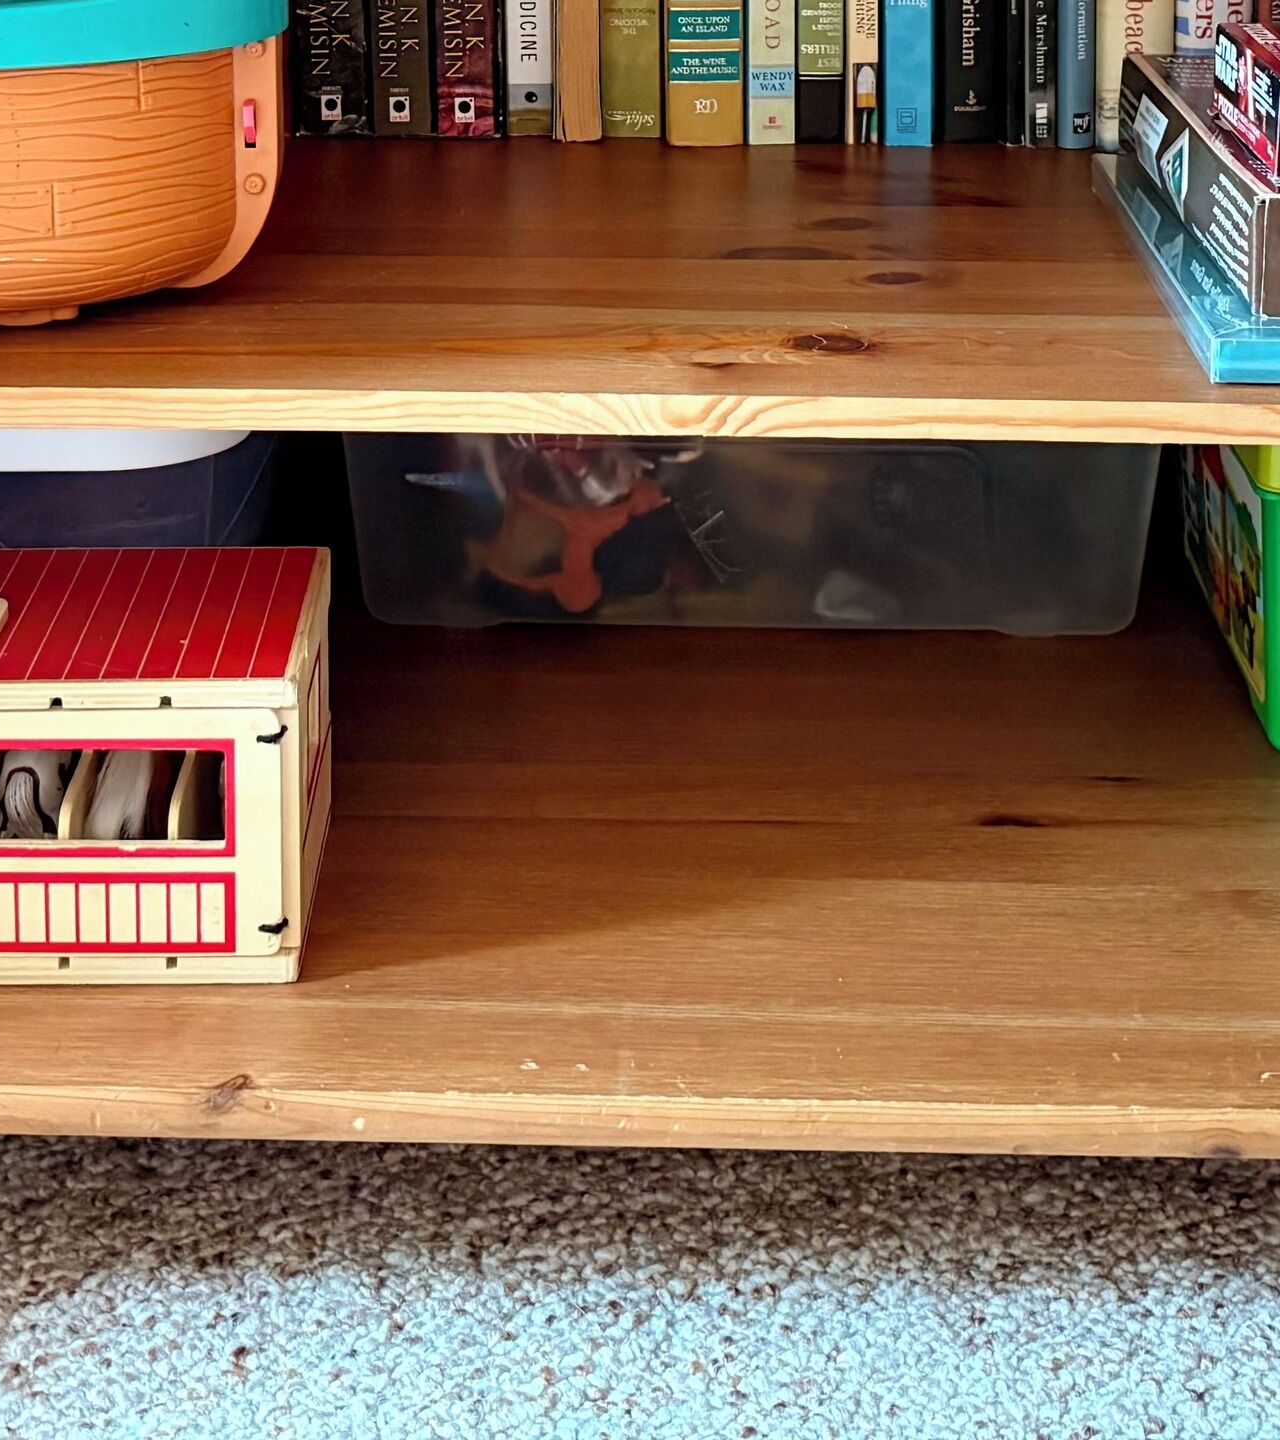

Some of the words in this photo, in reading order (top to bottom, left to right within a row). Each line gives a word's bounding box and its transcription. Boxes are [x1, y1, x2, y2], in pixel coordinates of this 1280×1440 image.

[677, 16, 704, 24] ONCE
[705, 16, 730, 24] UPON
[696, 25, 728, 33] ISLAND
[1035, 14, 1047, 84] Marshman
[710, 66, 738, 74] MUSIC
[751, 72, 794, 81] WENDY
[760, 82, 786, 91] WAX
